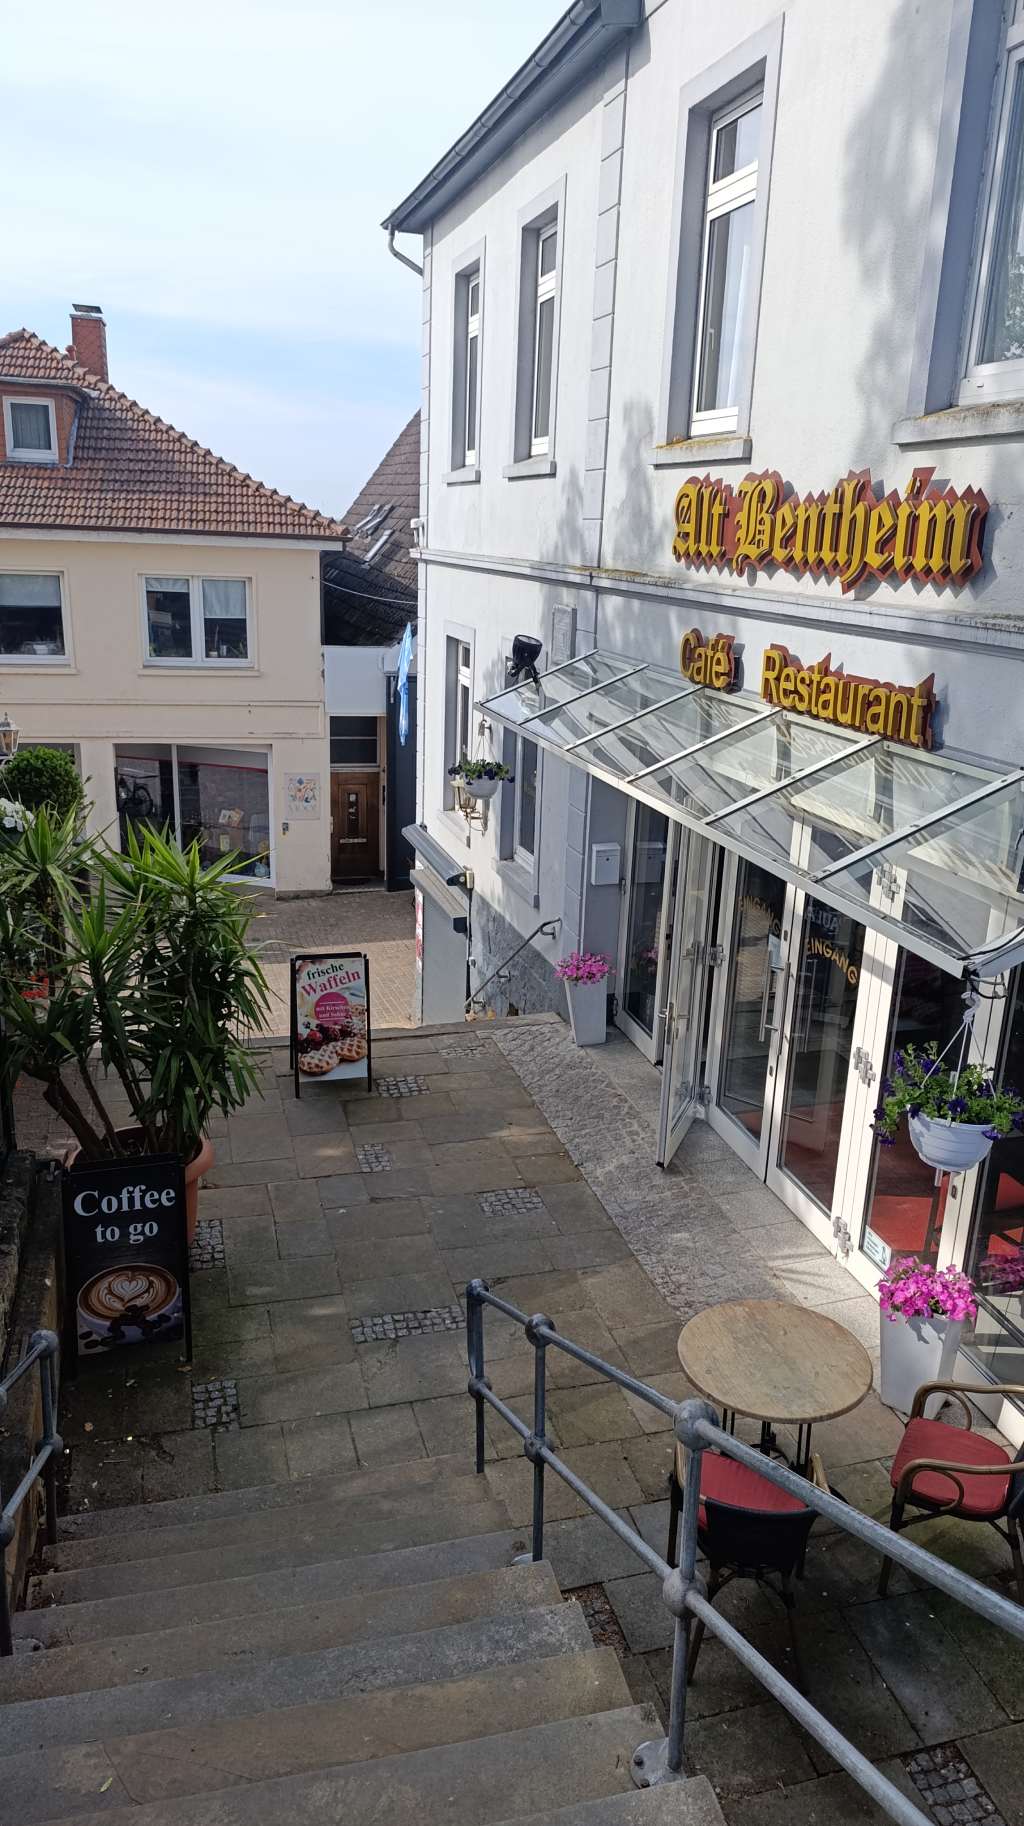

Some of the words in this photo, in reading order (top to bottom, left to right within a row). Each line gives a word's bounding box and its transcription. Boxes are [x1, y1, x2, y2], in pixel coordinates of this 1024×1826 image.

[672, 480, 729, 564] Alt
[732, 472, 980, 589] Bentheim
[680, 630, 733, 689] Café
[761, 648, 930, 745] Restaurant
[306, 963, 344, 980] frische
[805, 937, 858, 985] EINGANG
[301, 970, 361, 996] Waffeln
[73, 1184, 176, 1217] Coffee
[94, 1223, 120, 1243] to
[128, 1220, 159, 1245] go
